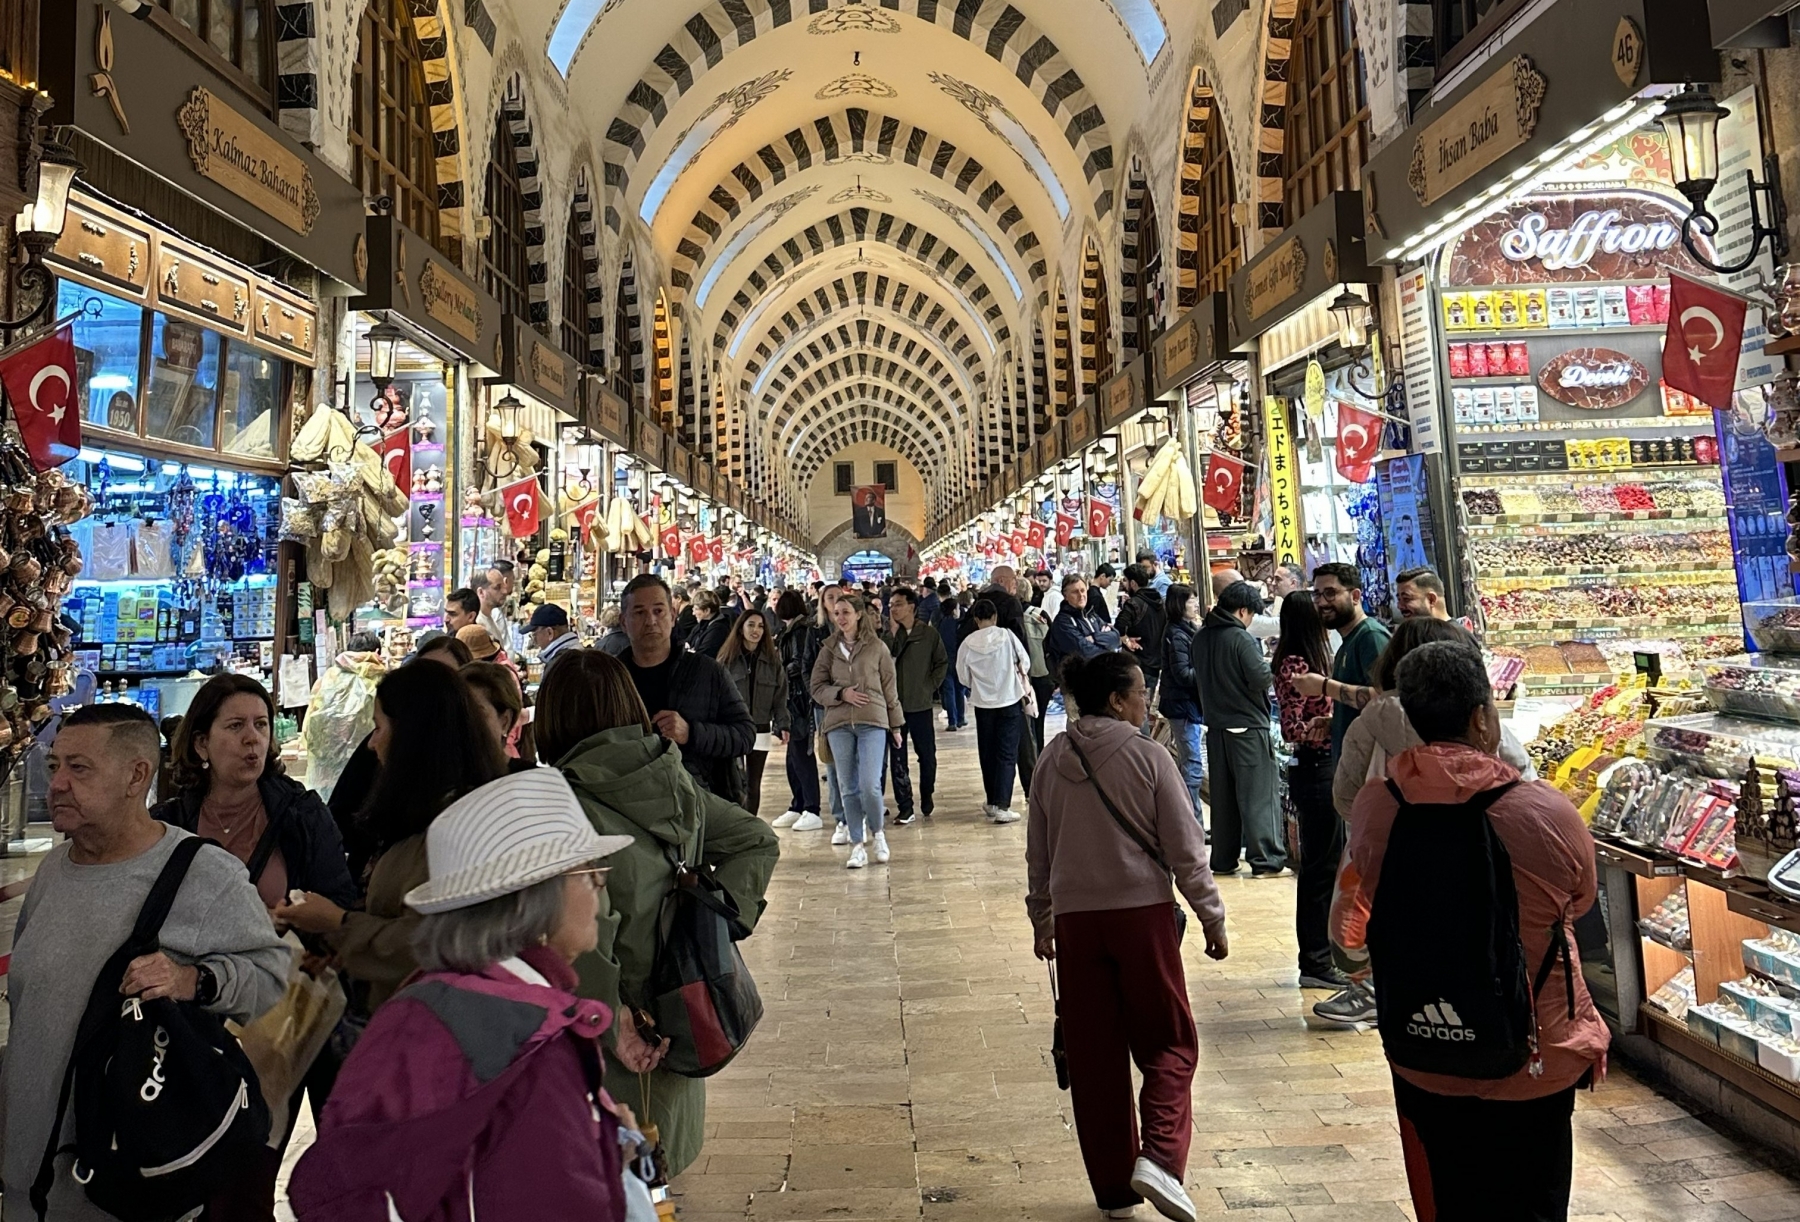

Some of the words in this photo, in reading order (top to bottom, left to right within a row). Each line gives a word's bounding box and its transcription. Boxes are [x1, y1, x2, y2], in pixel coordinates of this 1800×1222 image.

[1617, 33, 1634, 67] 46
[1438, 138, 1468, 174] İhsan
[1469, 105, 1499, 151] Baba
[212, 127, 257, 178] Kalmaz
[259, 159, 300, 206] Baharat
[1501, 209, 1682, 270] Saffron
[1559, 361, 1633, 388] Develi
[109, 408, 131, 428] 1950
[1406, 1022, 1476, 1042] adidas
